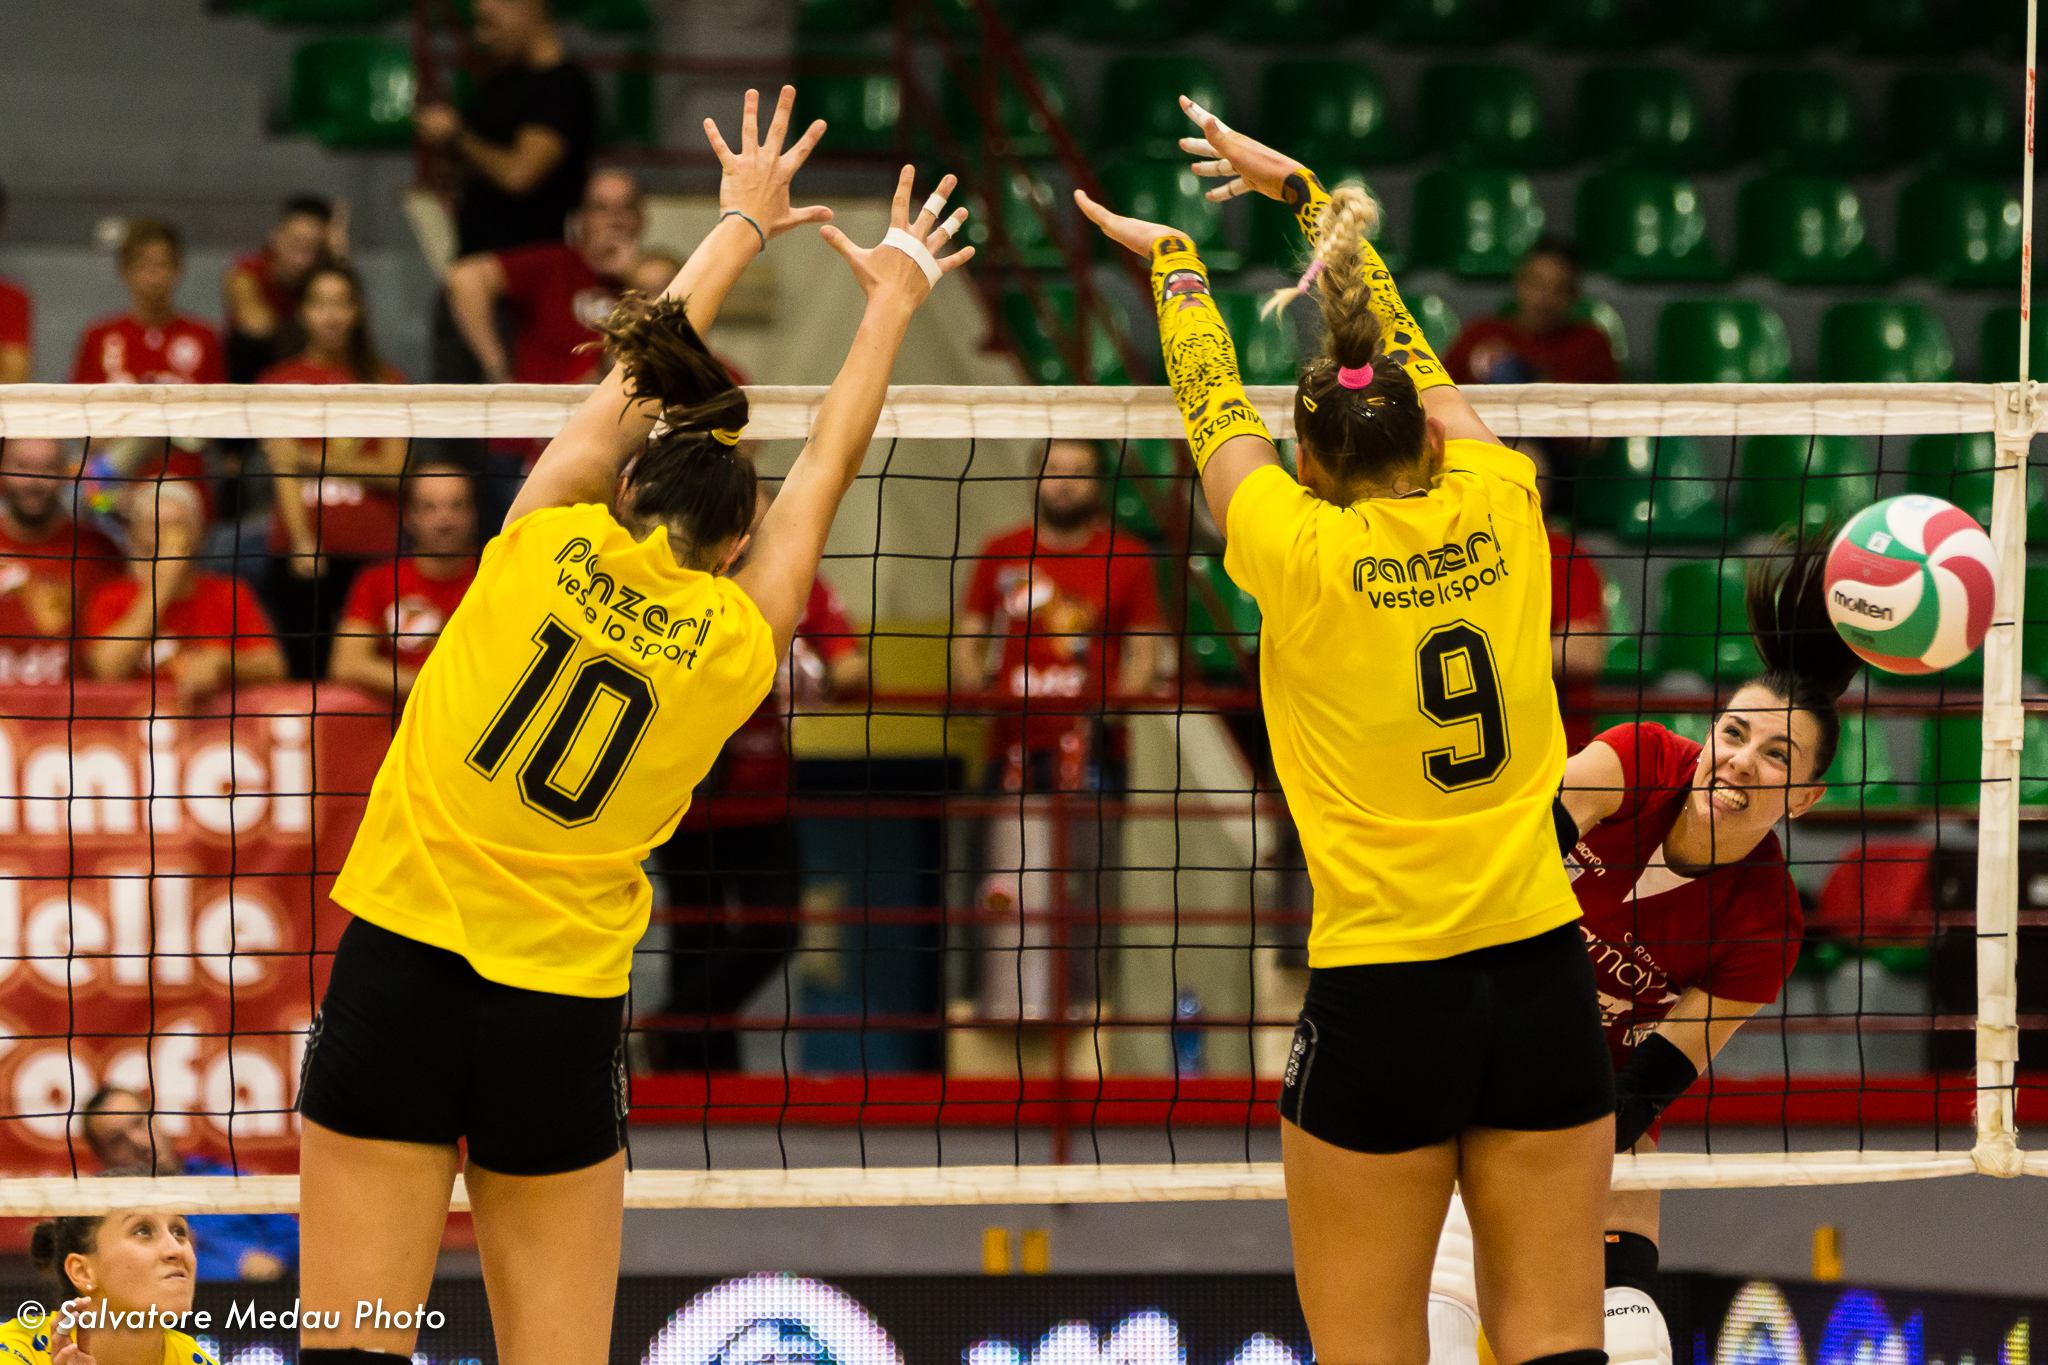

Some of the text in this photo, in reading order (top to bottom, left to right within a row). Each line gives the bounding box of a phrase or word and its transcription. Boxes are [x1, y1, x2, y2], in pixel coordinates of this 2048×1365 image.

[1450, 556, 1509, 602] sport
[1834, 590, 1895, 623] molten
[557, 567, 698, 670] vese lo sport
[464, 612, 660, 830] 10
[1414, 618, 1512, 794] 9
[1575, 841, 1606, 878] acron
